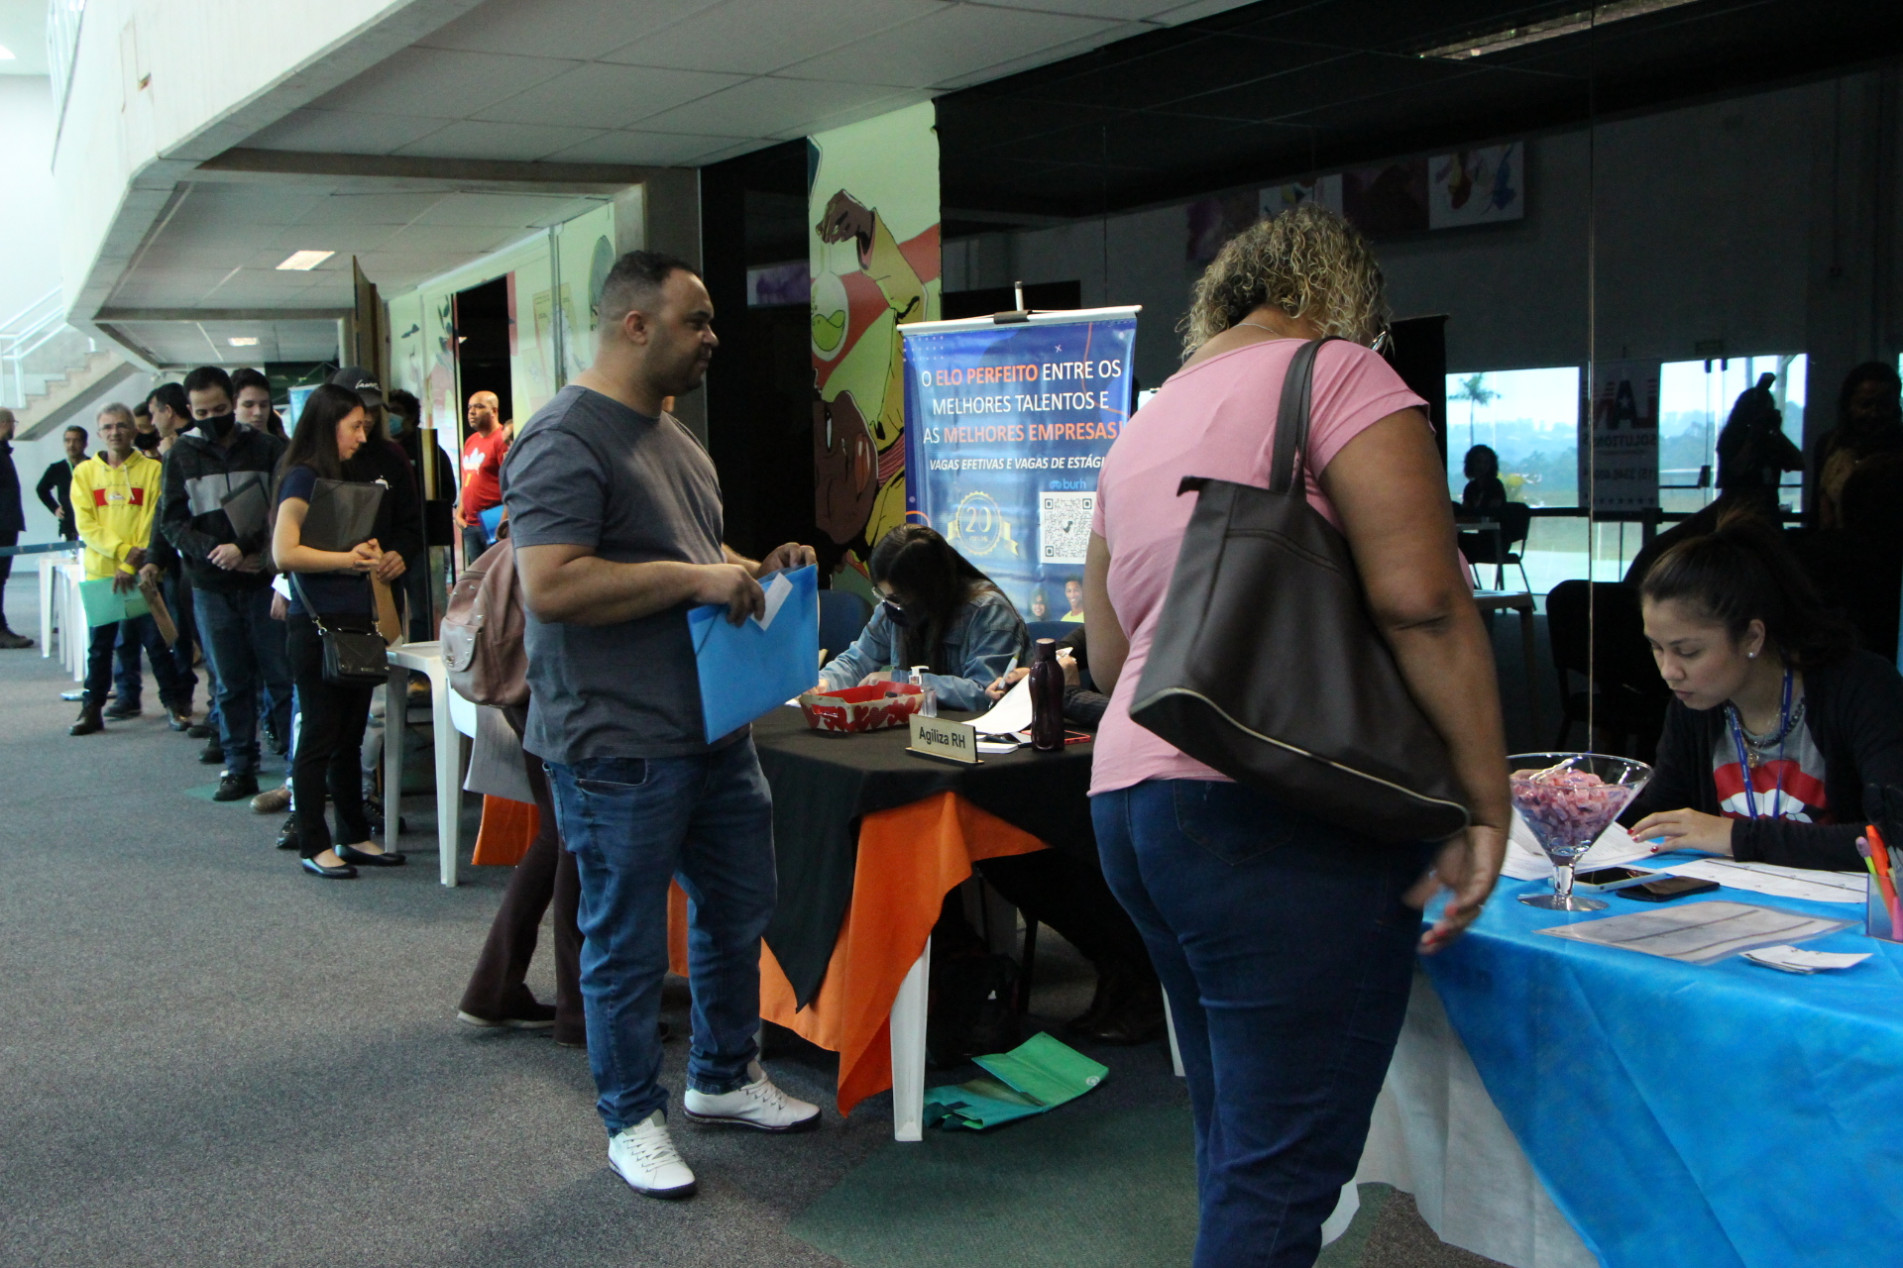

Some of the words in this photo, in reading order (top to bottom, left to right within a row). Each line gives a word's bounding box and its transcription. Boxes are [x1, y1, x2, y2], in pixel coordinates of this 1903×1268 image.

[921, 370, 932, 387] O
[936, 368, 963, 386] ELO
[967, 364, 1039, 384] PERFEITO
[1042, 361, 1093, 380] ENTRE
[1098, 359, 1122, 378] OS
[933, 395, 1011, 415] MELHORES
[1015, 391, 1095, 412] TALENTOS
[1100, 391, 1109, 409] E
[923, 427, 940, 444] AS
[944, 424, 1024, 443] MELHORES
[930, 459, 959, 471] VAGAS
[961, 458, 1004, 470] EFETIVAS
[1006, 458, 1013, 469] E
[1014, 457, 1049, 469] VAGAS
[1051, 457, 1066, 469] DE
[1067, 454, 1105, 469] ESTÁGI
[1062, 478, 1087, 490] burh
[966, 506, 992, 533] 20
[919, 726, 949, 746] Agiliza
[951, 732, 966, 749] RH
